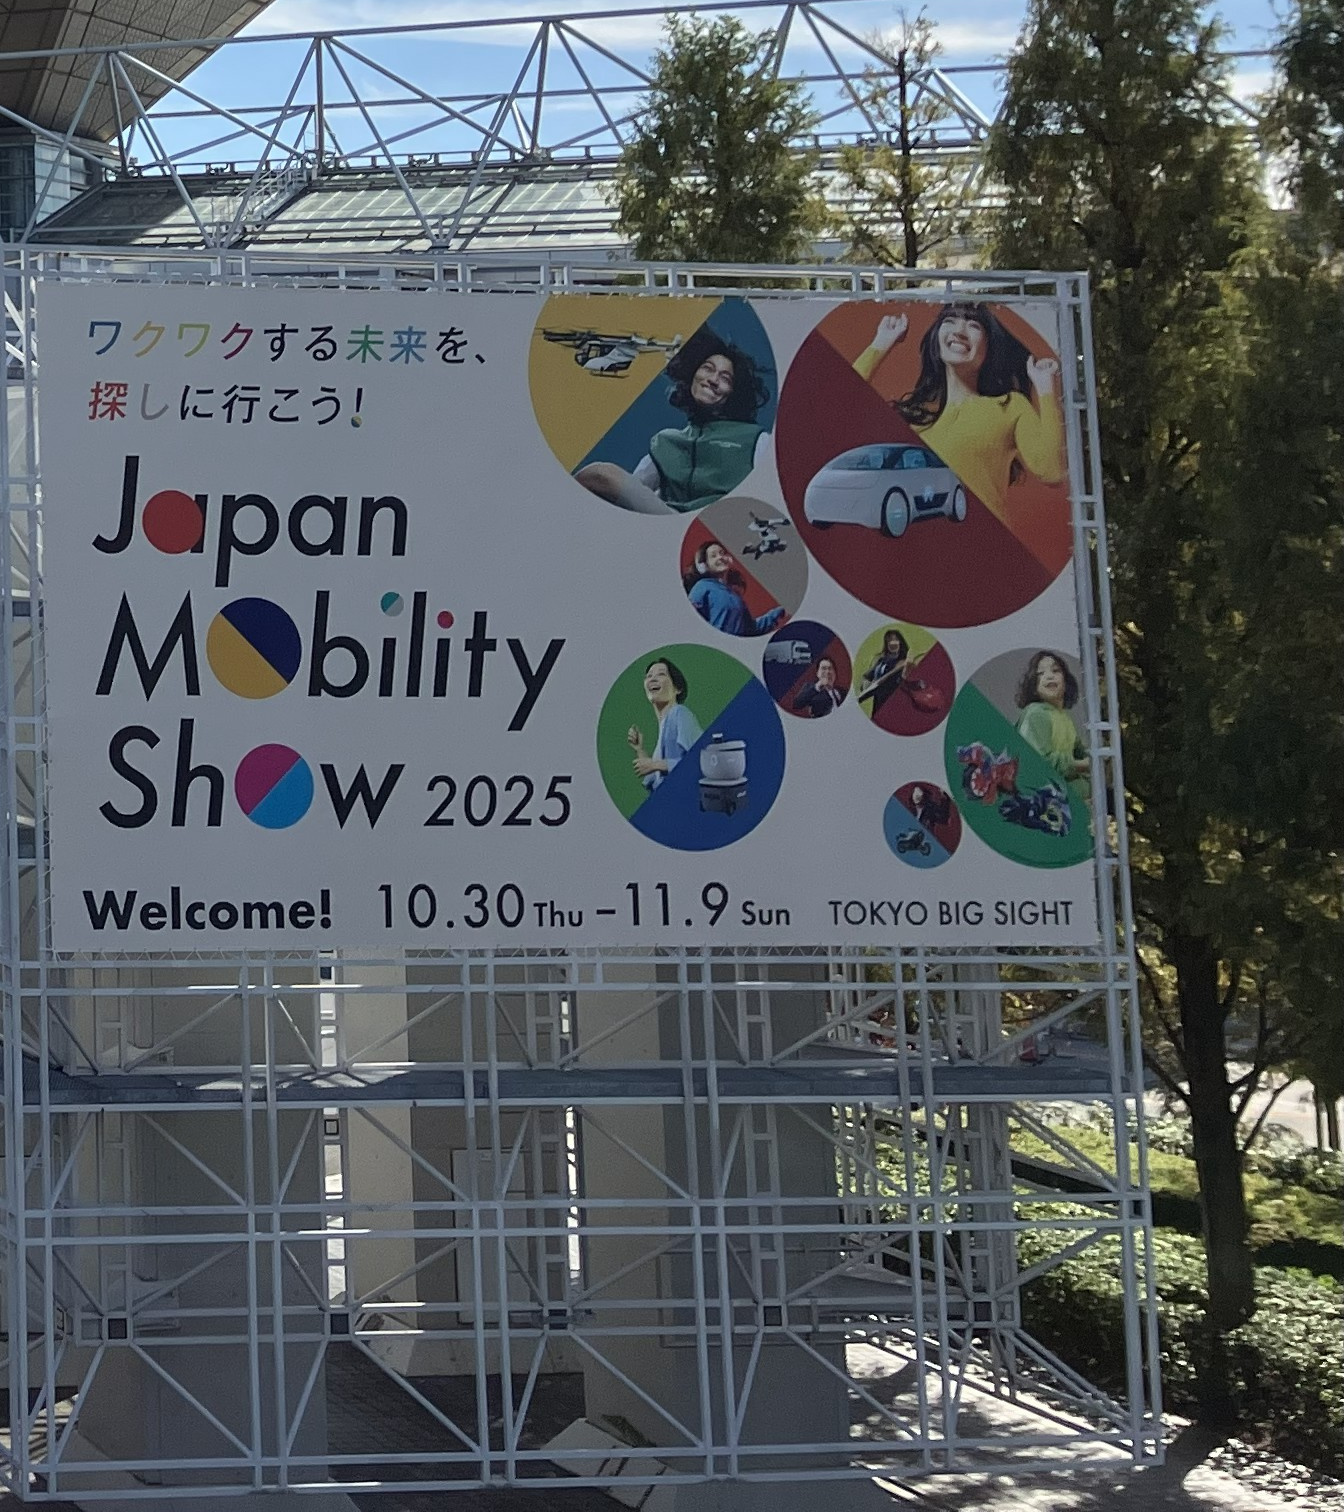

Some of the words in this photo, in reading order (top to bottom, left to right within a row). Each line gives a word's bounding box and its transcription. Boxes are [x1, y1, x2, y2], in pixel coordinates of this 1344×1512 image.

[88, 321, 488, 364] ワクワクする未来を、
[88, 381, 364, 429] 探しに行こう!
[91, 455, 409, 588] Japan
[95, 590, 567, 731] Mobility
[99, 718, 406, 830] Show
[423, 774, 572, 827] 2025
[82, 886, 332, 930] Welcome!
[378, 883, 525, 930] 10.30
[533, 901, 584, 928] Thu
[741, 901, 791, 927] Sun
[828, 900, 927, 926] TOKYO
[938, 900, 984, 926] BIG
[994, 900, 1073, 926] SIGHT
